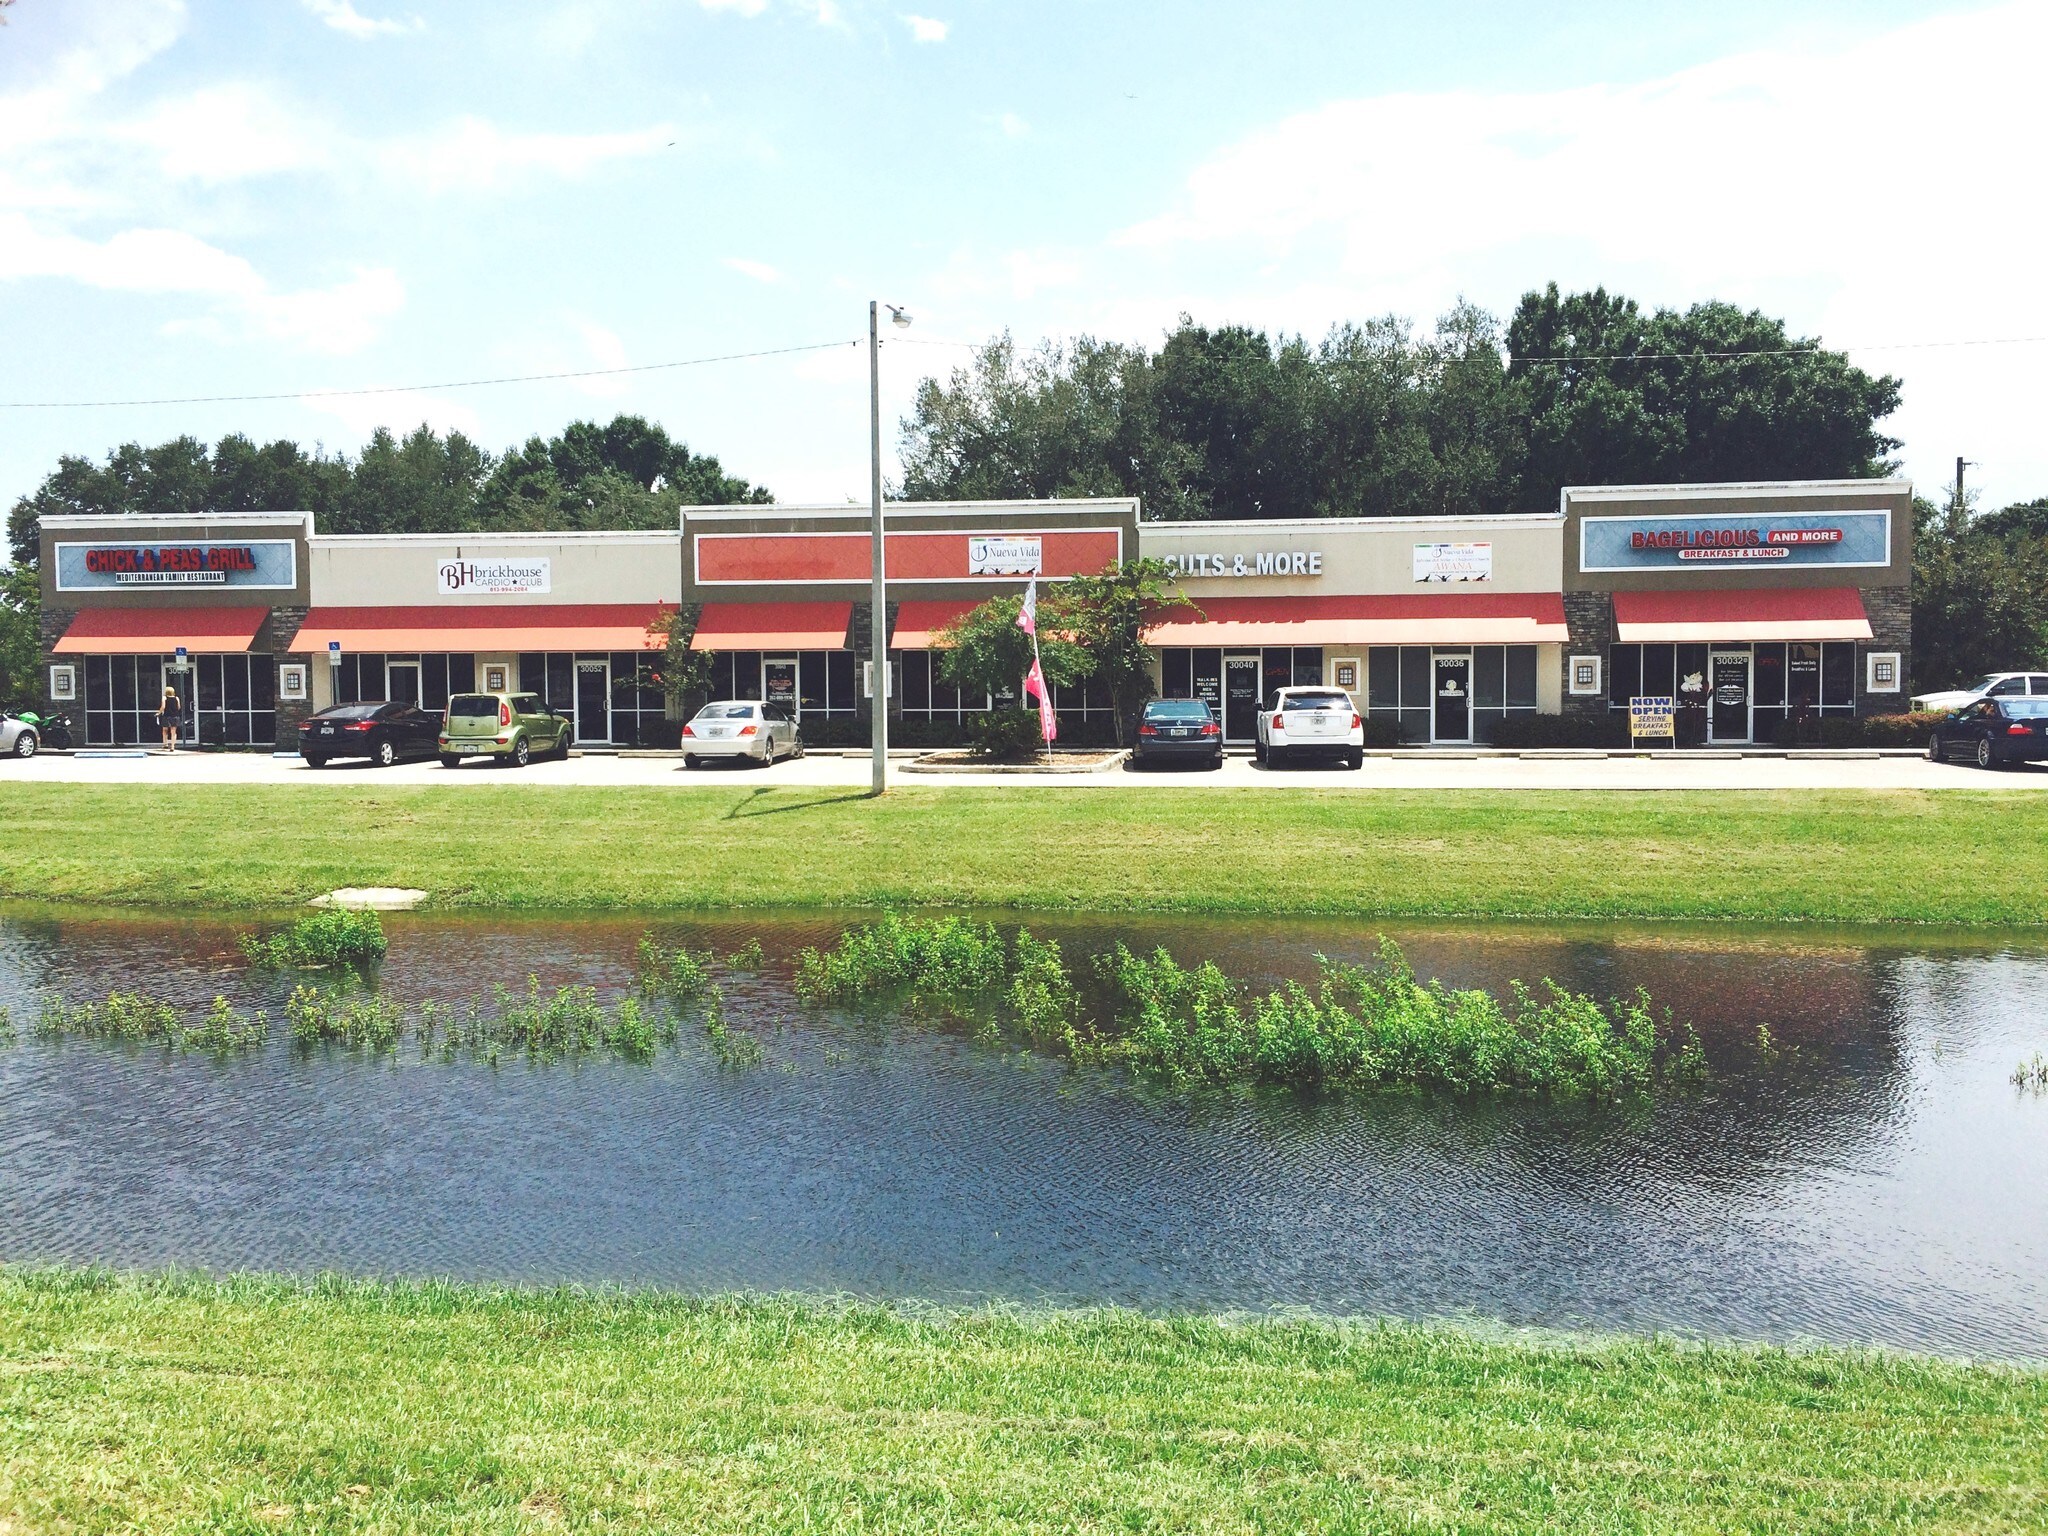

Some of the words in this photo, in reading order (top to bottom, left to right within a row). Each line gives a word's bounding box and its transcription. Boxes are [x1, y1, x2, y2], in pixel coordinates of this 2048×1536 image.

[1631, 529, 1760, 548] BAGELICIOUS
[1773, 532, 1798, 541] AND
[1802, 531, 1838, 541] MORE
[990, 547, 1017, 557] Nueva
[1020, 546, 1040, 557] Vida
[1684, 549, 1739, 558] BREAKFAST
[1742, 549, 1748, 557] &
[1752, 549, 1784, 557] LUNCH
[86, 550, 137, 572] CHICK
[143, 549, 154, 571] &
[160, 548, 201, 571] PEAS
[208, 547, 255, 570] GRILL
[1164, 553, 1225, 577] CUTS
[1233, 553, 1248, 577] &
[1256, 551, 1322, 576] MORE
[475, 565, 542, 577] brickhouse
[1434, 562, 1472, 570] AWANA
[117, 573, 164, 582] MEDITERRANEAN
[165, 572, 185, 581] FAMILY
[187, 572, 225, 581] RESTAURANT
[475, 578, 510, 586] CARDIO
[519, 578, 543, 586] CLUB
[1229, 661, 1254, 669] 30040
[1632, 707, 1672, 715] OPEN
